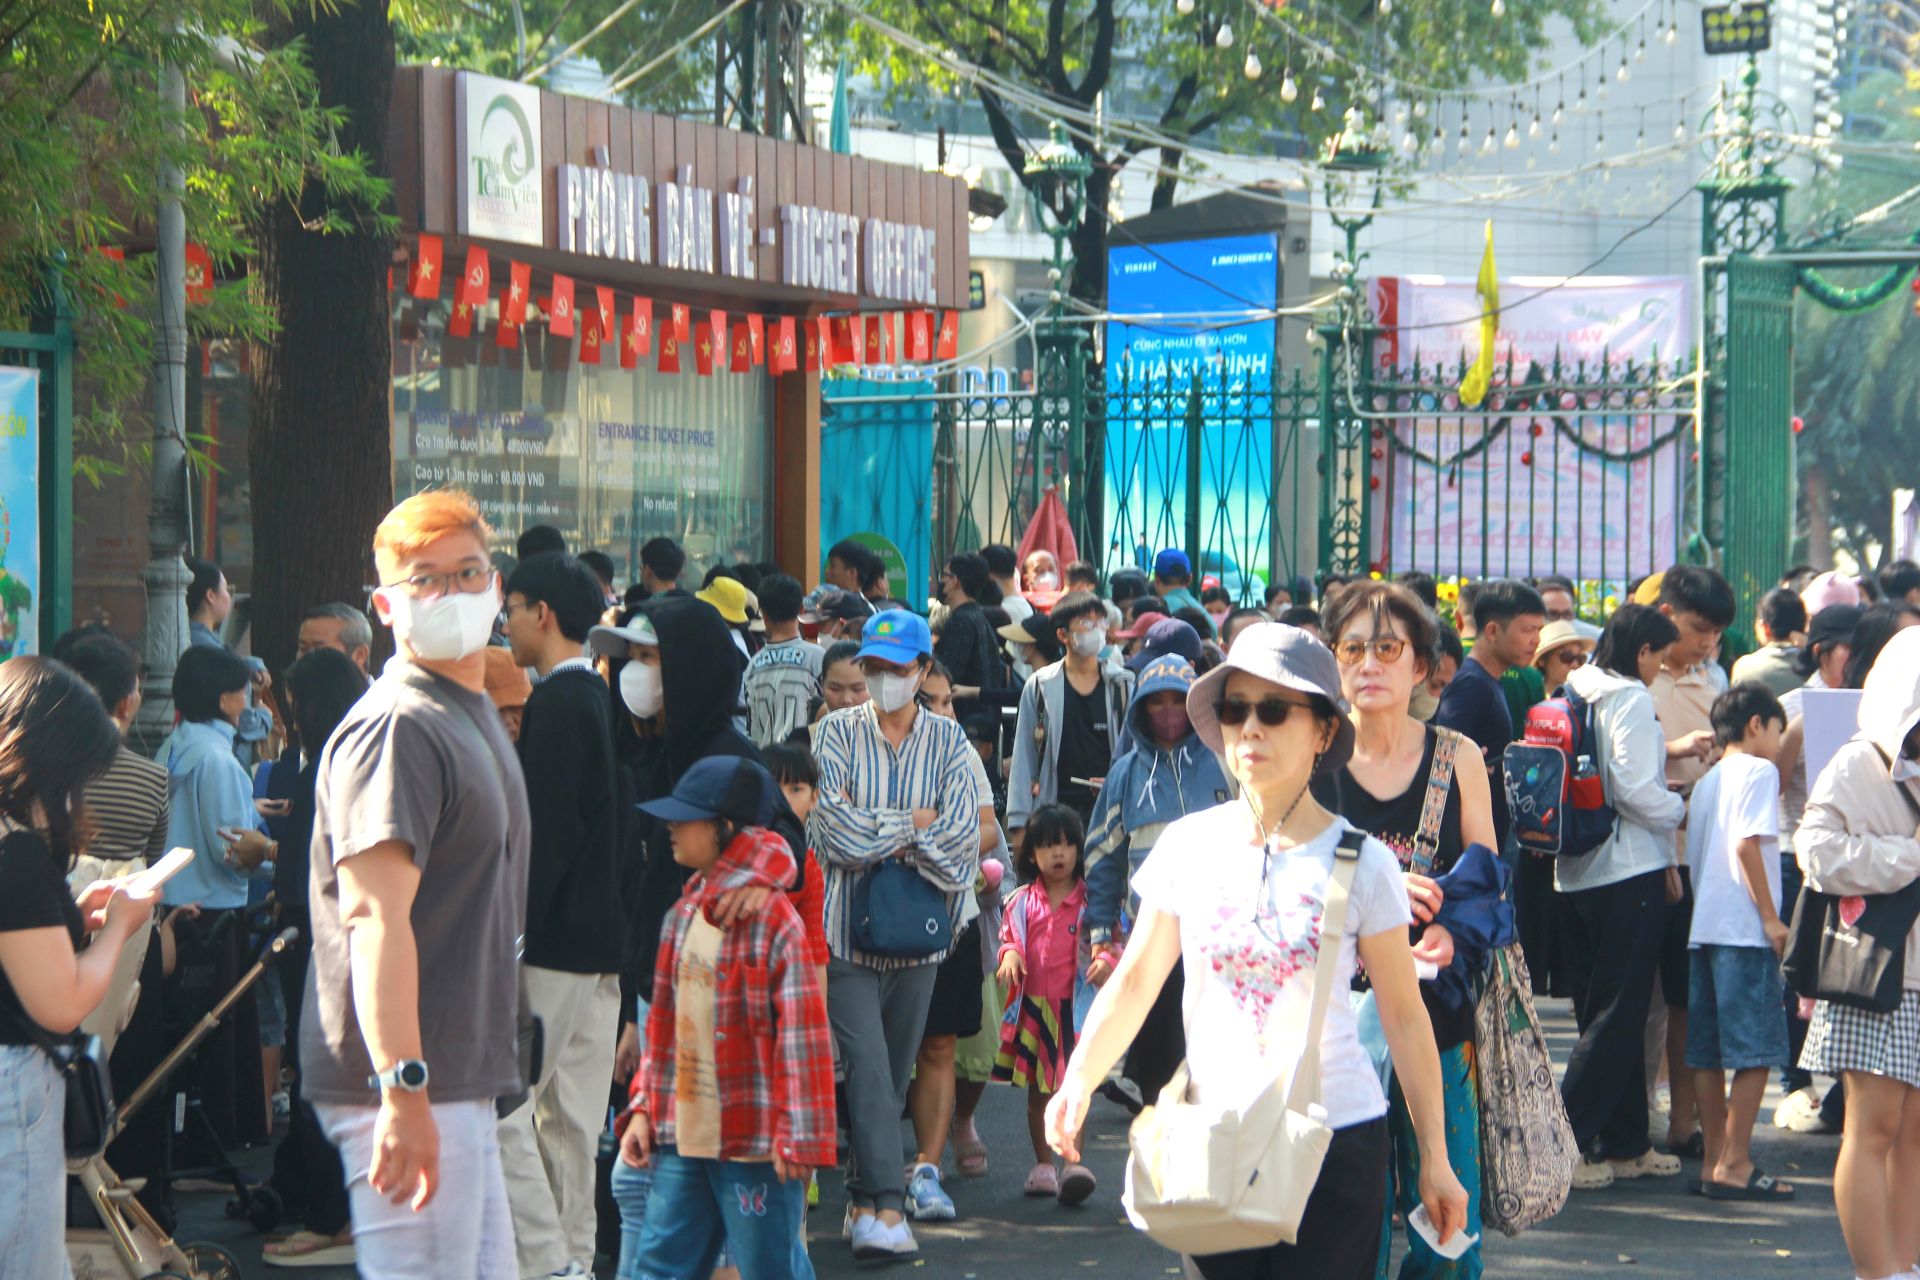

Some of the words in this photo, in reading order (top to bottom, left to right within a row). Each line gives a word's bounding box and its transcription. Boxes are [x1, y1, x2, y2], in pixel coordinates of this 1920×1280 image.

[558, 145, 651, 265] PHÒNG
[656, 164, 714, 274] BÁN
[718, 175, 755, 281] VÉ
[780, 204, 860, 295] TICKET
[864, 218, 937, 306] OFFICE
[1163, 334, 1193, 350] NHAU
[598, 422, 650, 442] ENTRANCE
[652, 425, 685, 446] TICKET
[687, 429, 715, 448] PRICE
[415, 463, 433, 480] Cao
[643, 495, 654, 510] No
[655, 496, 678, 512] refund
